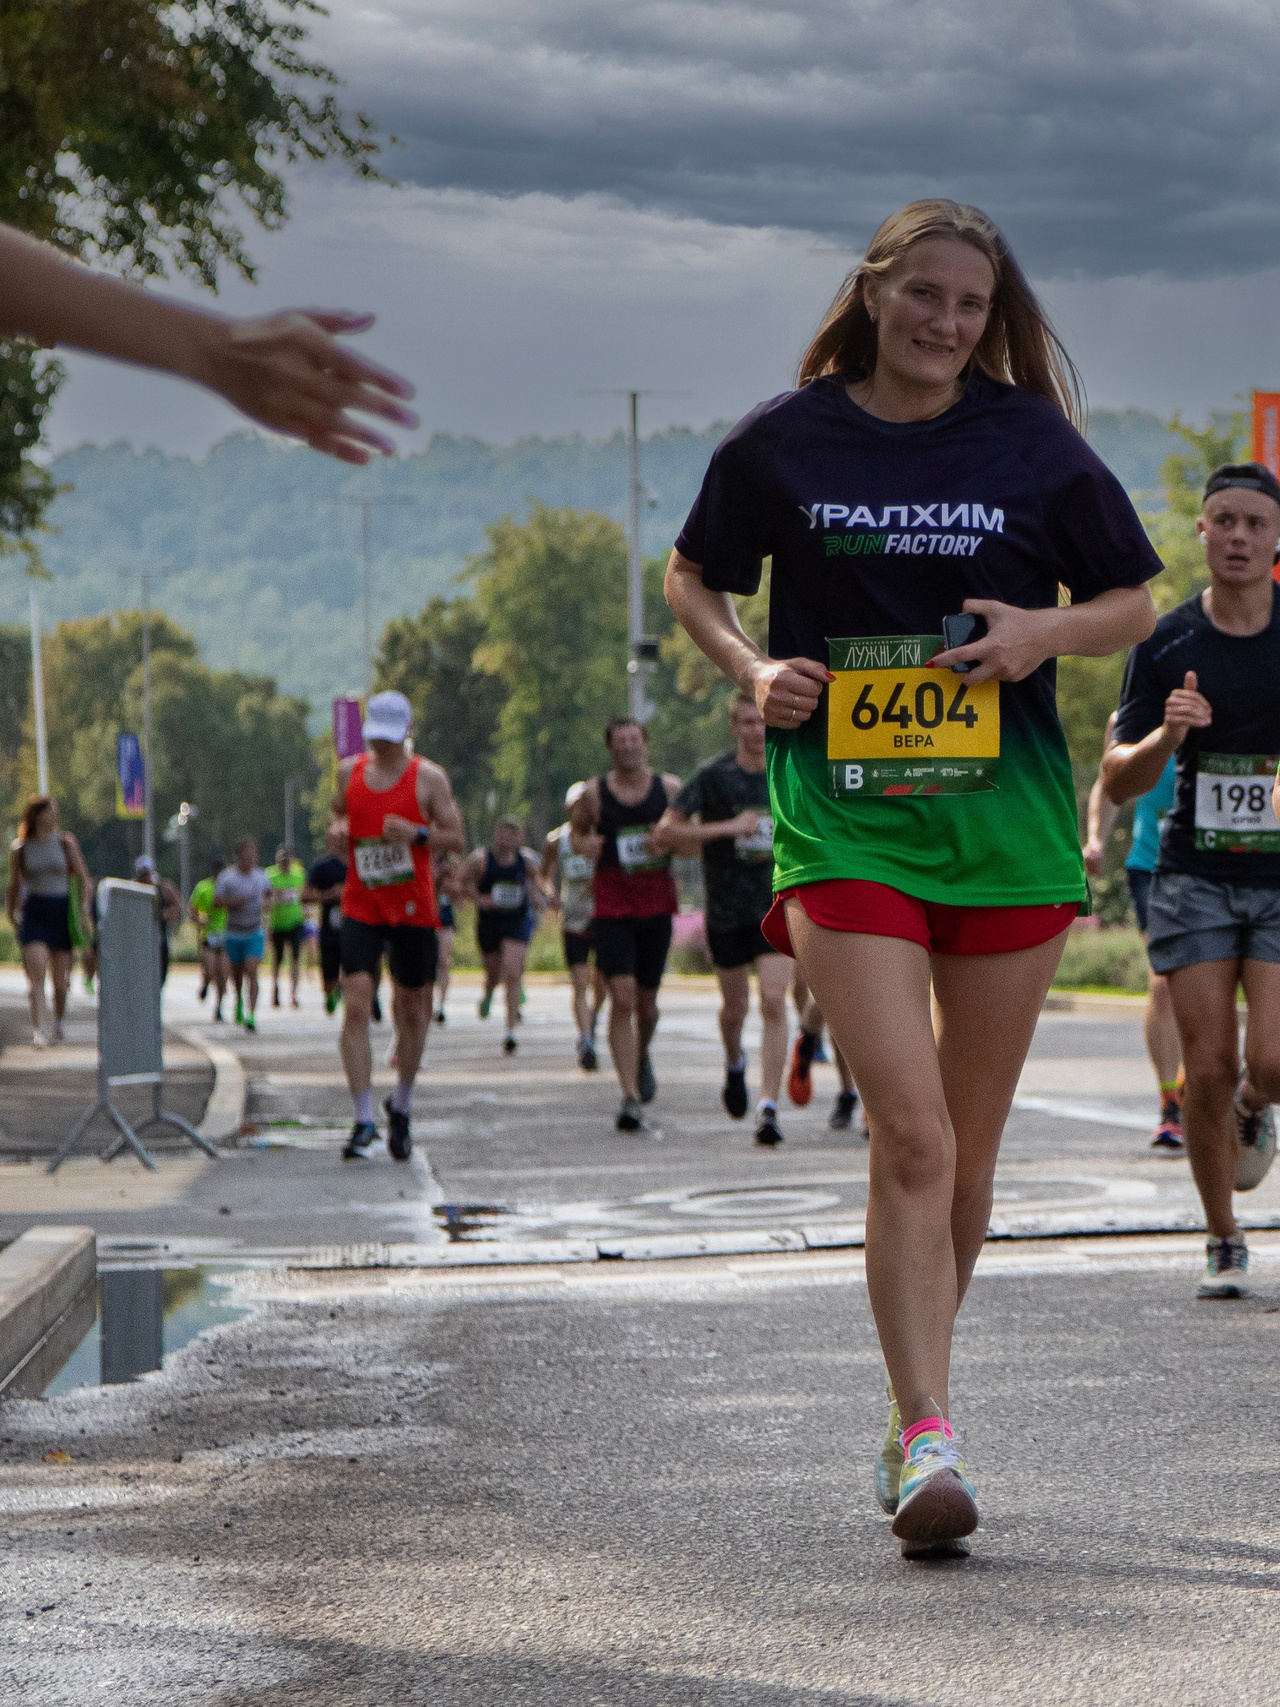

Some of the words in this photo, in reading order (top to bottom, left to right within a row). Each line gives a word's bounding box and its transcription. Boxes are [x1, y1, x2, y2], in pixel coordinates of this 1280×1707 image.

[798, 503, 1005, 533] УРАЛХИМ
[844, 643, 920, 668] ЛУЖНИКИ
[851, 681, 979, 731] 6404
[893, 734, 934, 748] ВЕРА
[845, 764, 864, 790] B
[1211, 783, 1275, 812] 198
[1204, 830, 1217, 849] C
